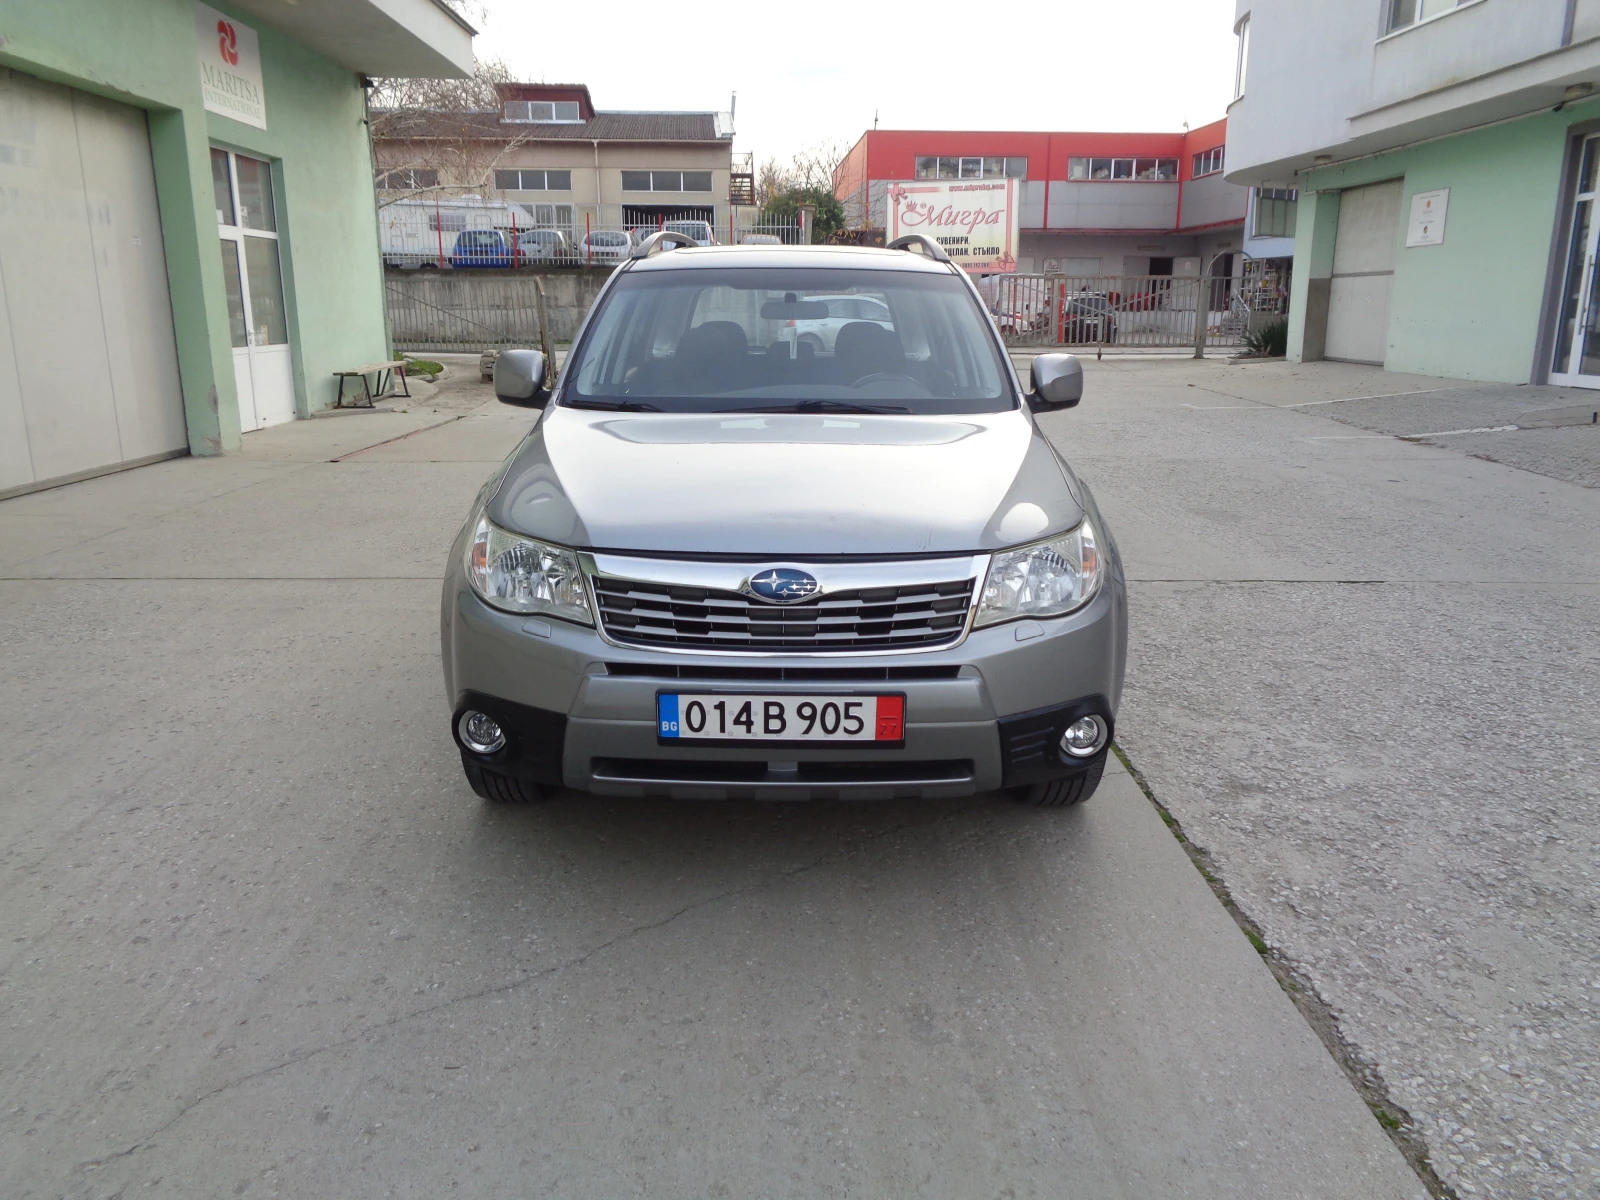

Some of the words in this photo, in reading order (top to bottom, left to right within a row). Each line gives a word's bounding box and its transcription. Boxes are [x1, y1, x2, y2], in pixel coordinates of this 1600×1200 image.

[201, 61, 260, 105] MARITSA
[203, 88, 261, 119] INTERNATIONAL
[900, 204, 1006, 235] Мигра
[973, 246, 1000, 255] СТЪКЛО
[662, 721, 678, 731] BG
